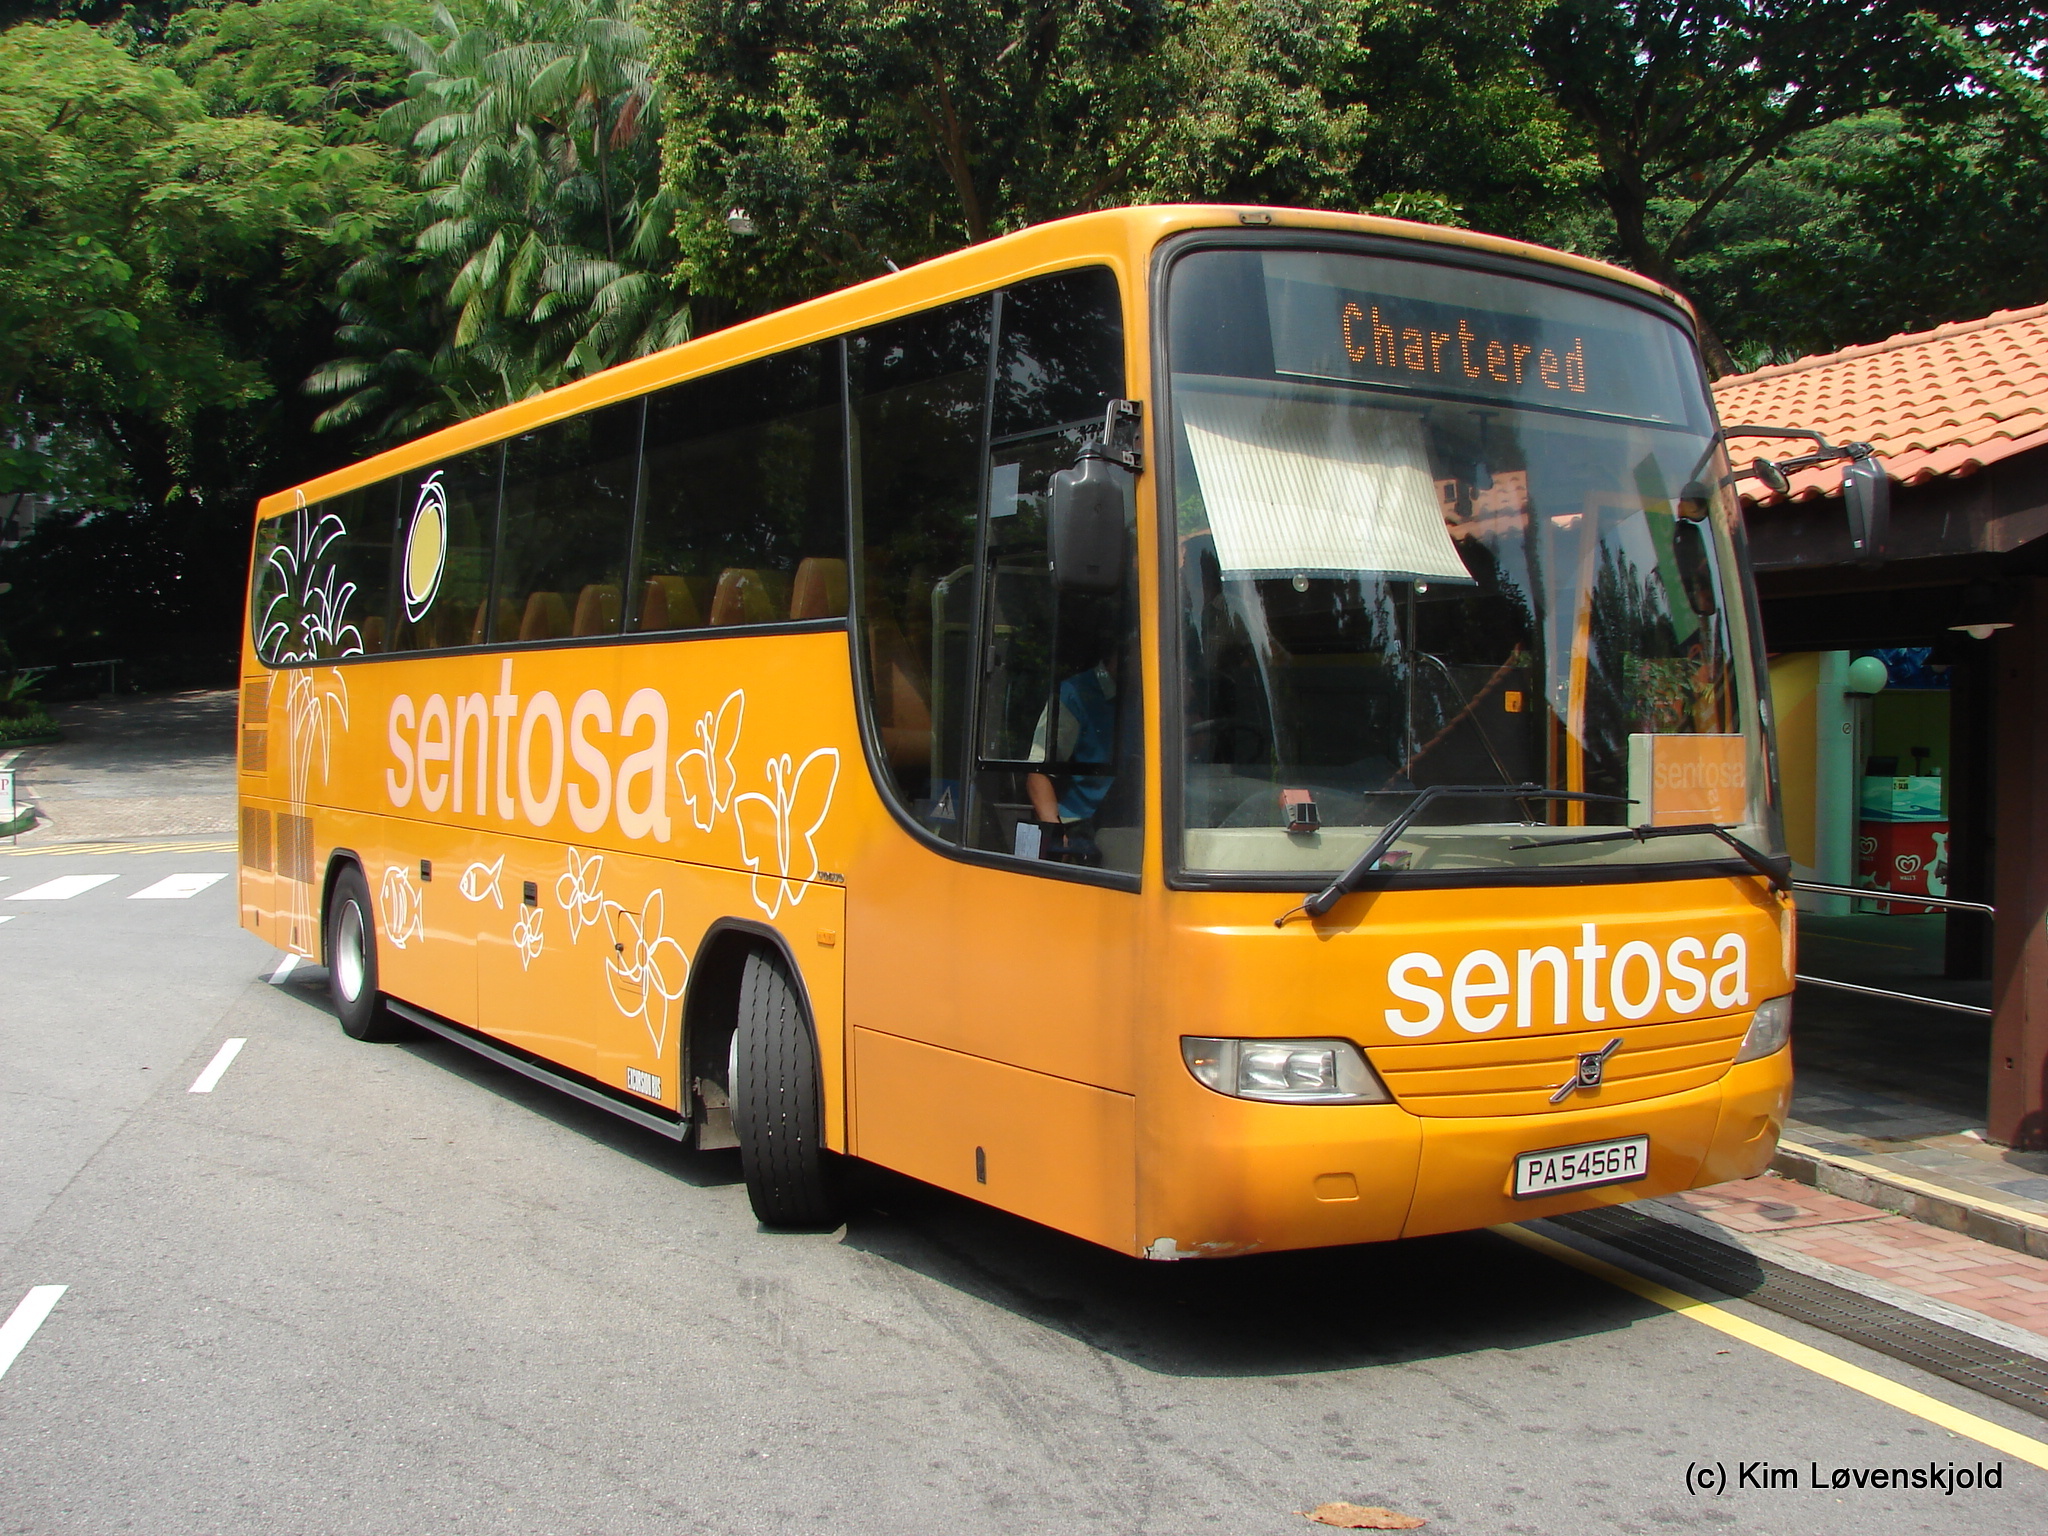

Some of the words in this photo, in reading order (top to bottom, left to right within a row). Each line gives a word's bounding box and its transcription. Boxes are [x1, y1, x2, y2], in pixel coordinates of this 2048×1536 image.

[1342, 302, 1586, 393] Chartered
[386, 658, 672, 843] sentosa
[1654, 757, 1745, 789] sentosa
[1384, 922, 1749, 1037] sentosa
[1527, 1145, 1637, 1187] PA5456R
